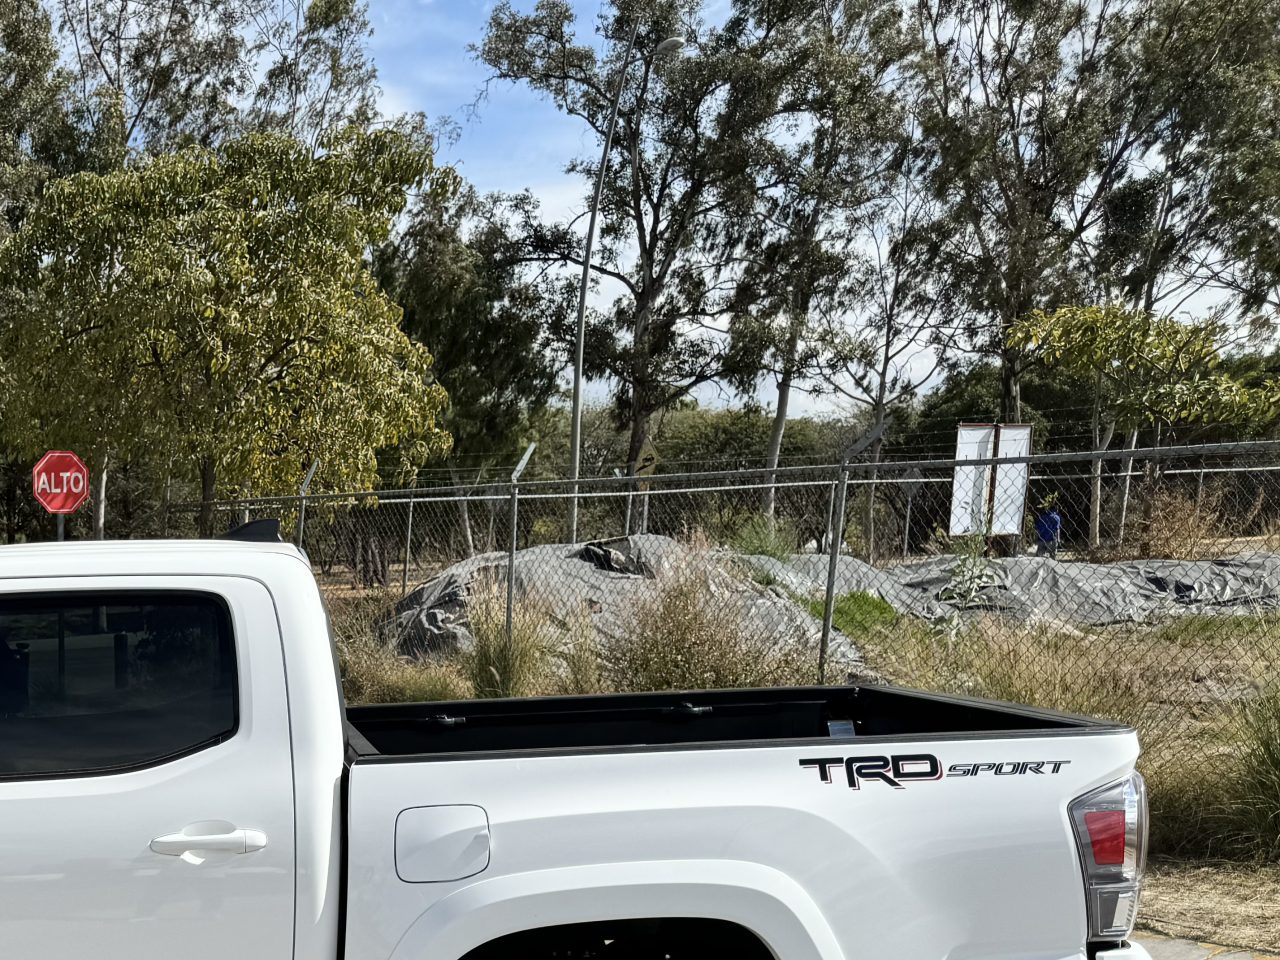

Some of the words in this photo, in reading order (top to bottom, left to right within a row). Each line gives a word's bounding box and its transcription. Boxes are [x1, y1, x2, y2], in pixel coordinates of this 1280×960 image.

[37, 471, 84, 494] ALTO
[798, 754, 943, 790] TRD
[946, 760, 1071, 777] SPORT
